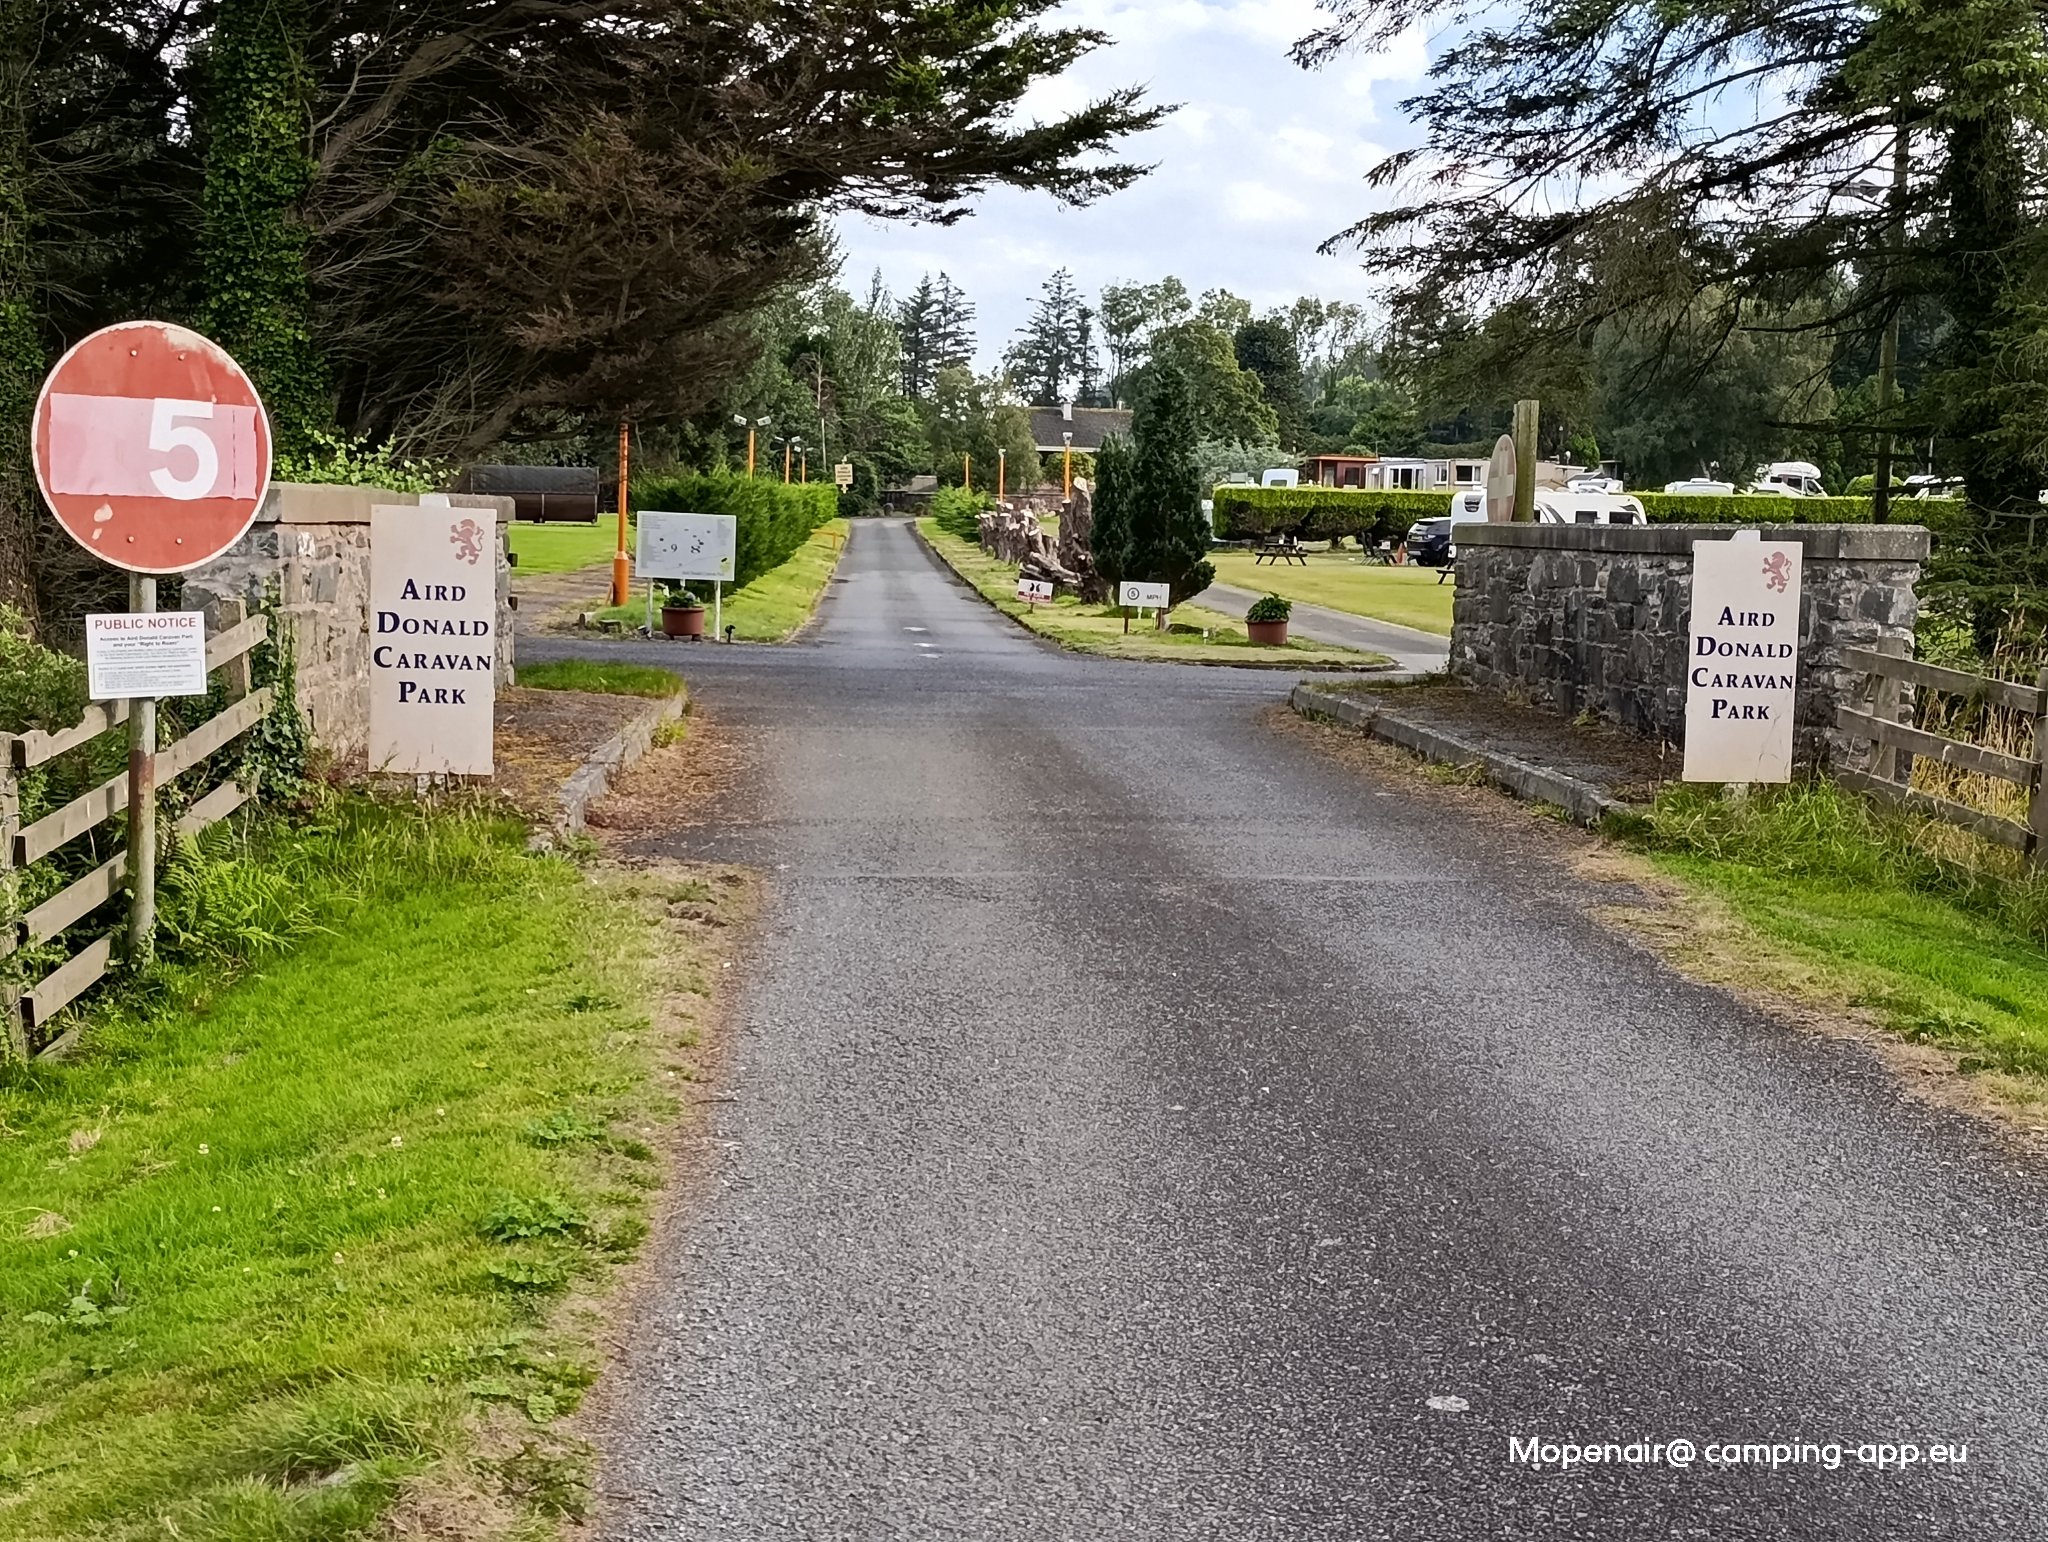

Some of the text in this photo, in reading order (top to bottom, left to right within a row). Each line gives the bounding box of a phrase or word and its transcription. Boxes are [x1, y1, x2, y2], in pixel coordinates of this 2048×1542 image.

[149, 398, 218, 500] 5
[400, 578, 467, 602] AIRD
[95, 617, 197, 630] PUBLIC NOTICE
[377, 611, 490, 636] DONALD
[1717, 606, 1776, 627] AIRD
[373, 646, 492, 671] CARAVAN
[1696, 636, 1794, 658] DONALD
[1691, 667, 1794, 690] CARAVAN
[398, 681, 467, 705] PARK
[1711, 698, 1770, 720] PARK
